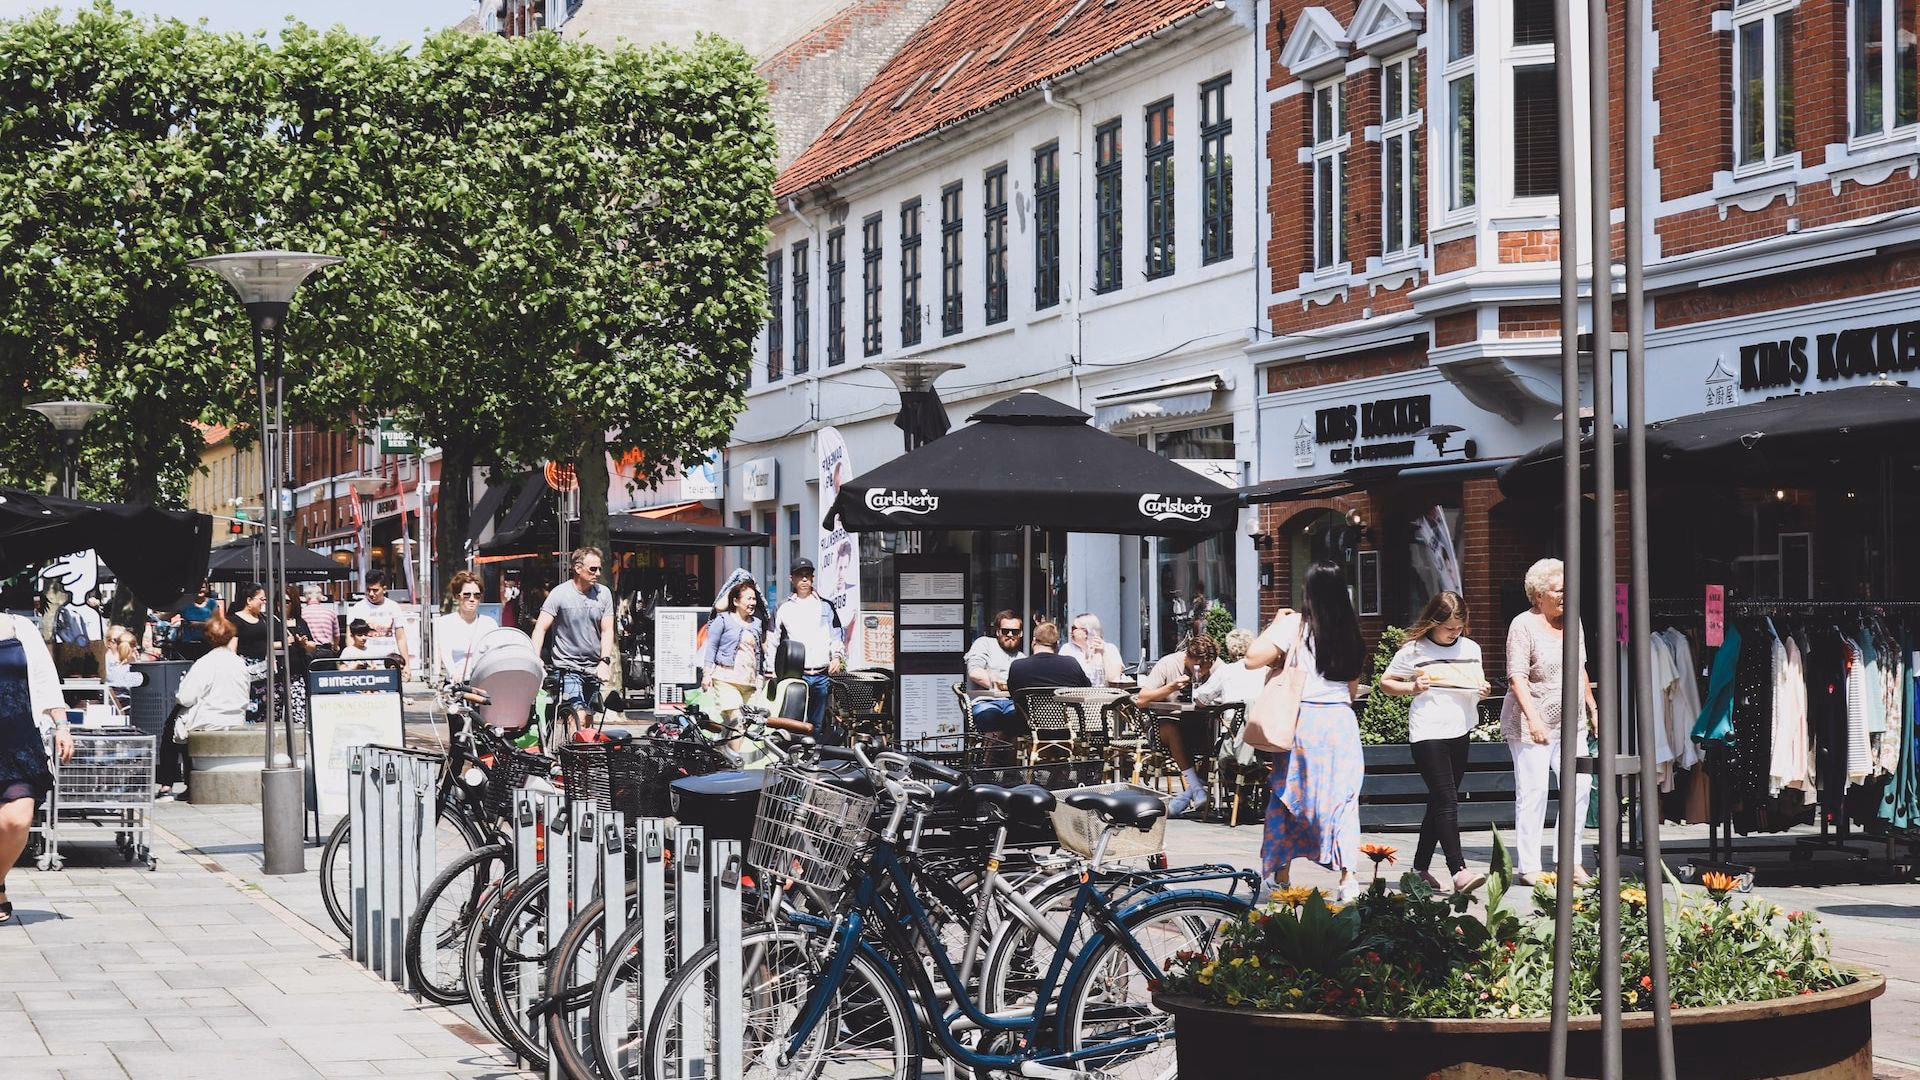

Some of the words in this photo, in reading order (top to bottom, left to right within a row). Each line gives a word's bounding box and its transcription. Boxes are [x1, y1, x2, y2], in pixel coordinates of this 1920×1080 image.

[864, 487, 940, 515] Carlsberg
[1138, 493, 1212, 521] Carlsberg
[329, 675, 376, 687] IMERCO
